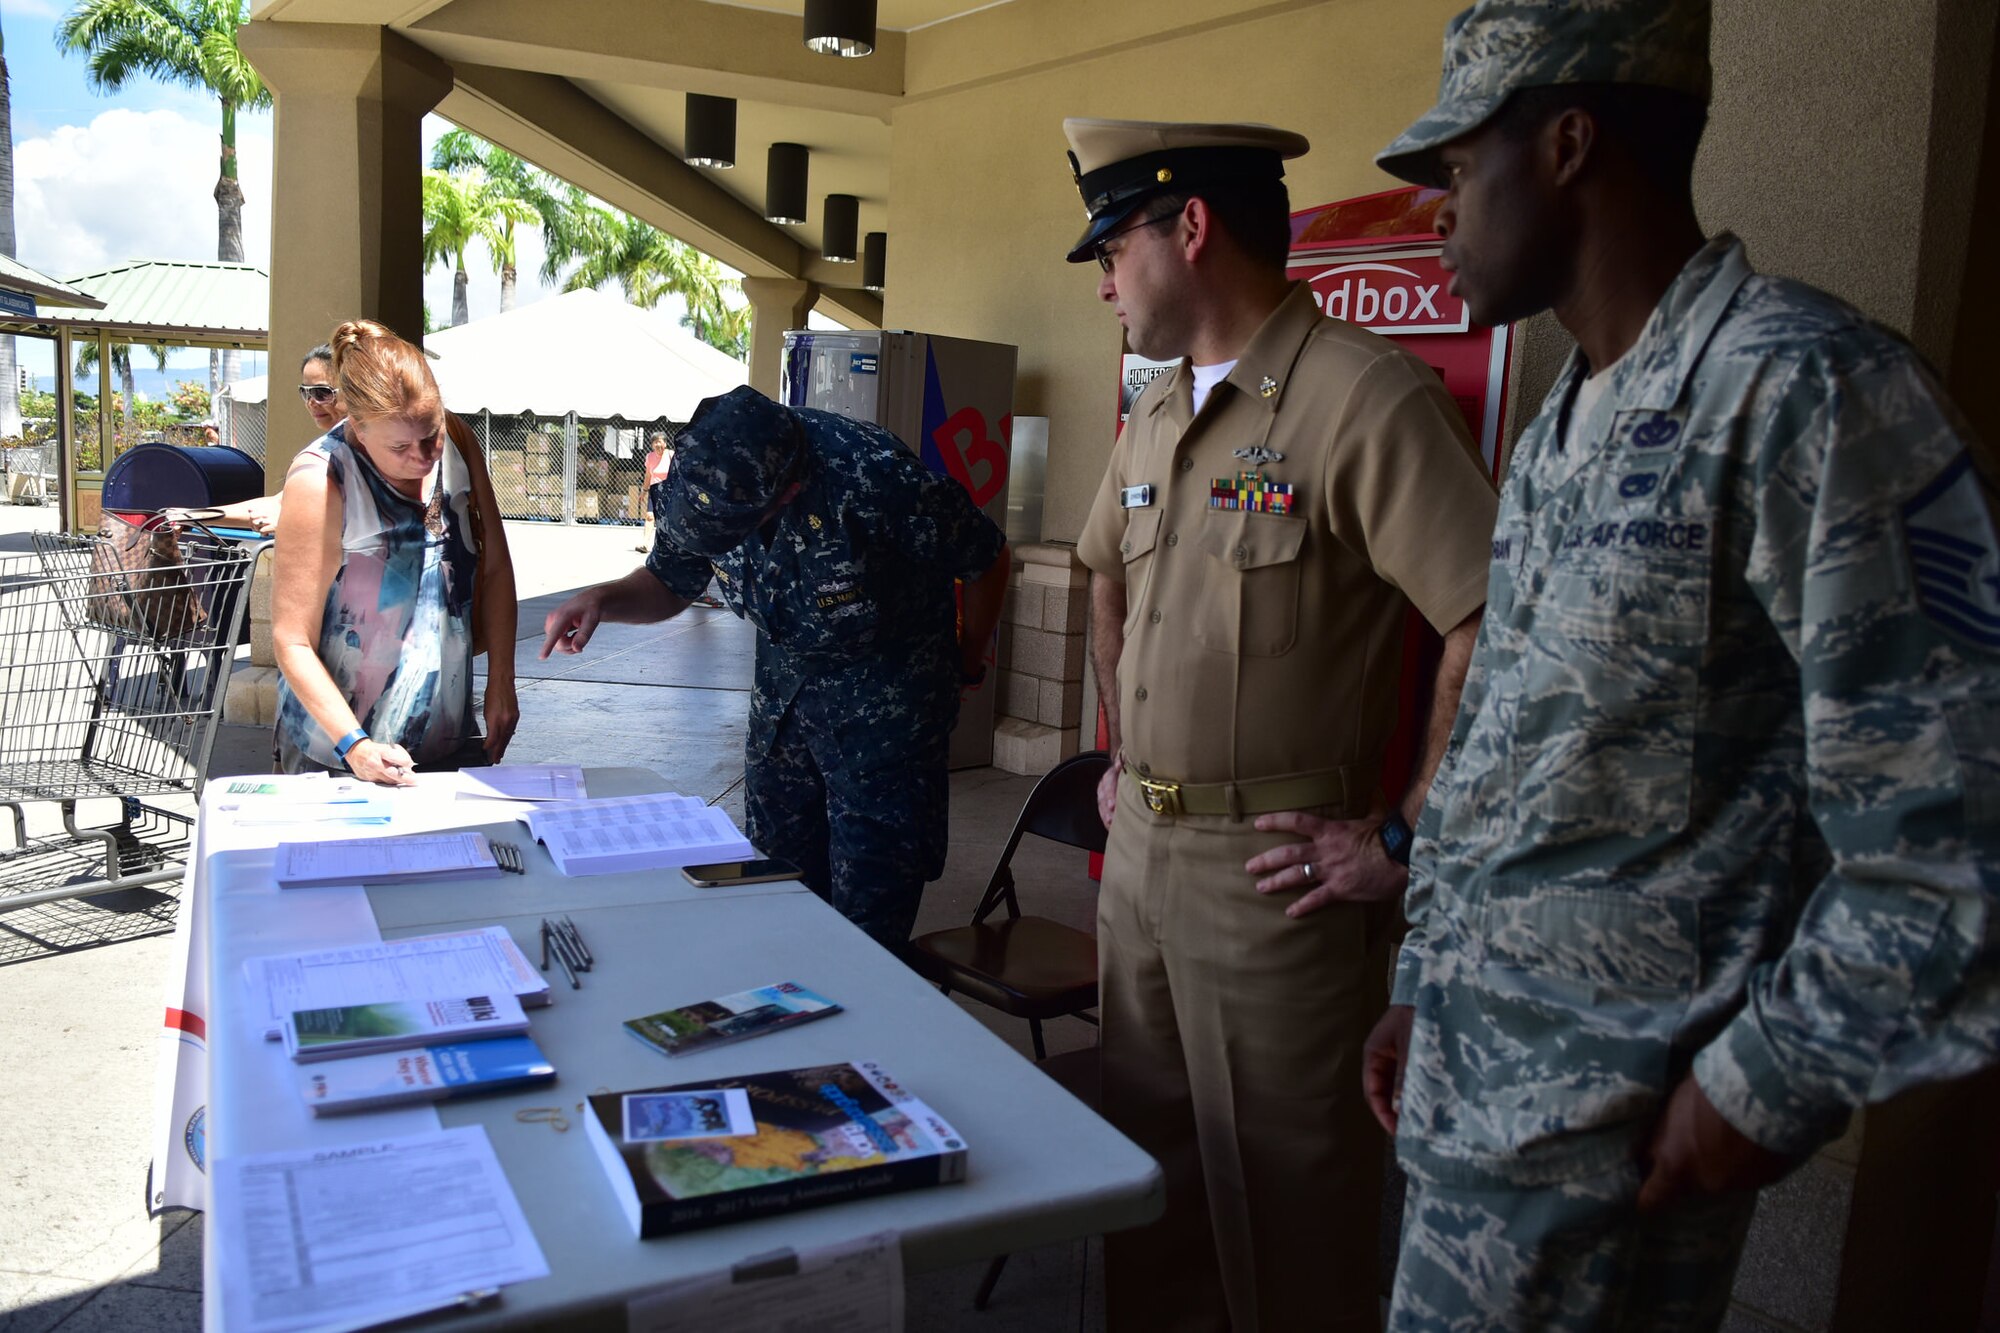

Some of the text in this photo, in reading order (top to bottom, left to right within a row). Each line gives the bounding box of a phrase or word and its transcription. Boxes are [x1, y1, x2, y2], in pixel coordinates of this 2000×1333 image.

[1621, 520, 1705, 550] FORCE
[816, 586, 865, 609] U.S. NAVY
